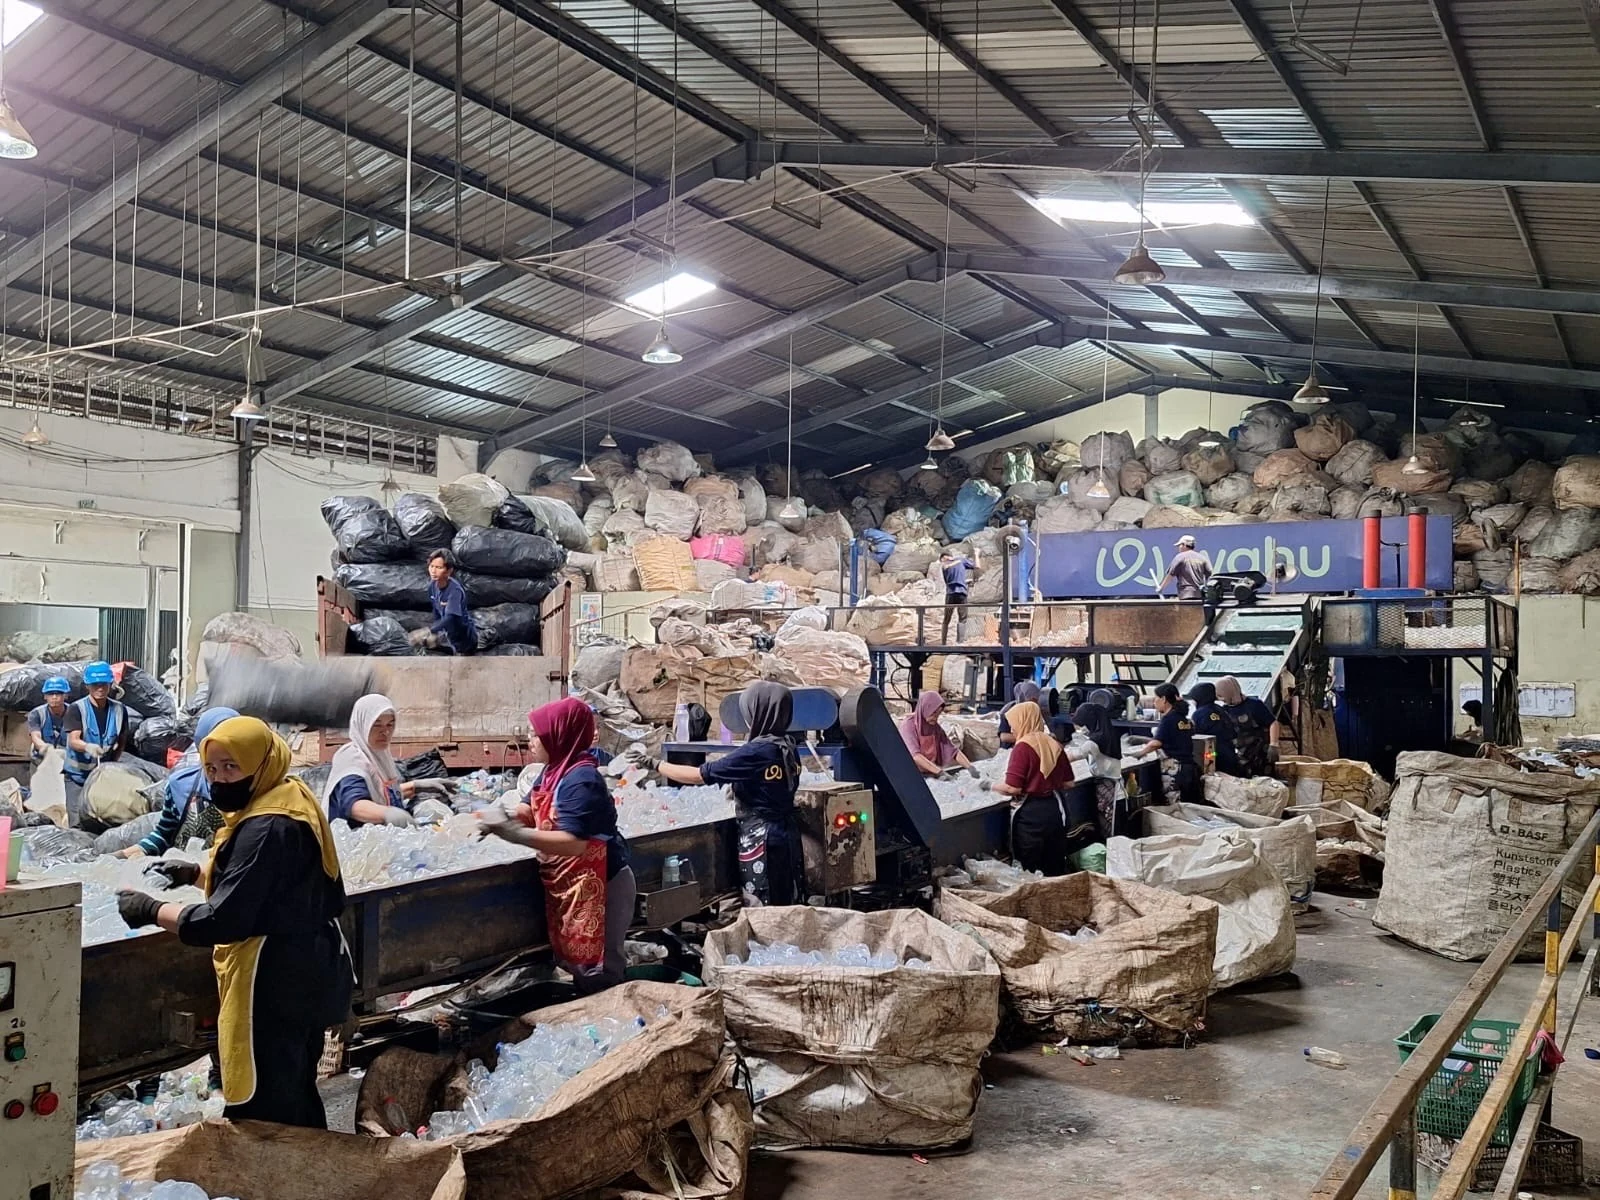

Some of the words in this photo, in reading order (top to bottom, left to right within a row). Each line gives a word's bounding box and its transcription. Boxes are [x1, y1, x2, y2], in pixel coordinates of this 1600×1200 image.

[1517, 828, 1549, 841] BASF
[1495, 847, 1560, 867] Kunststoffe
[1493, 860, 1542, 877] Plastics
